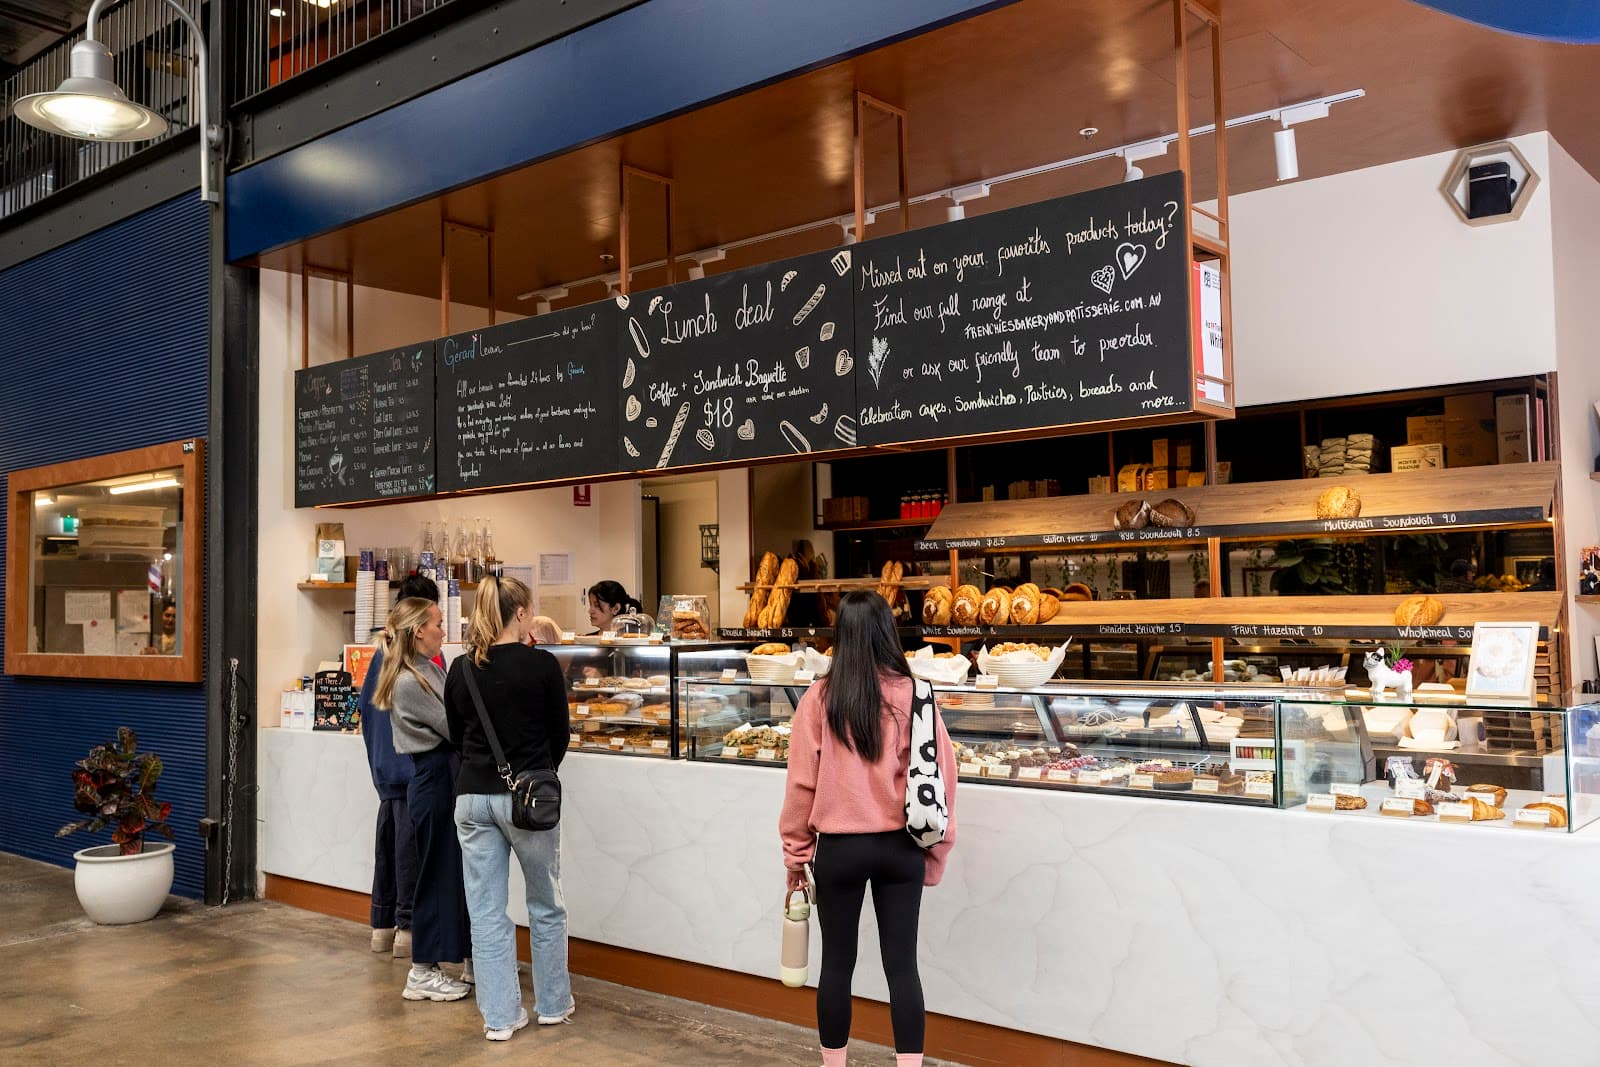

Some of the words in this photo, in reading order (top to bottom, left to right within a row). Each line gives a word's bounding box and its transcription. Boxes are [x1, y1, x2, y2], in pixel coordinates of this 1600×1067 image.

[860, 256, 903, 291] Missed
[907, 248, 927, 279] out
[933, 260, 947, 275] on
[1066, 217, 1119, 254] products
[1124, 201, 1178, 250] today?
[659, 292, 717, 344] Lunch
[735, 280, 775, 330] deal
[873, 295, 907, 331] Find
[913, 304, 934, 320] our
[938, 293, 961, 334] full
[972, 293, 1007, 319] range
[1016, 276, 1032, 302] at
[903, 366, 914, 379] or
[921, 362, 942, 382] ask
[948, 355, 969, 373] our
[975, 341, 1020, 383] friendly
[1032, 341, 1060, 361] team
[1070, 335, 1086, 356] to
[649, 381, 679, 407] Coffee
[693, 363, 742, 395] Sandwich
[745, 358, 787, 392] Baguette
[859, 399, 912, 427] Celebration
[1079, 373, 1123, 398] breads
[1129, 370, 1158, 393] and
[704, 397, 733, 428] $18
[1186, 527, 1201, 538] 8.5
[1442, 513, 1457, 524] 9.0
[1169, 623, 1182, 633] 15
[1312, 626, 1323, 636] 10
[1398, 626, 1453, 639] Wholemeal
